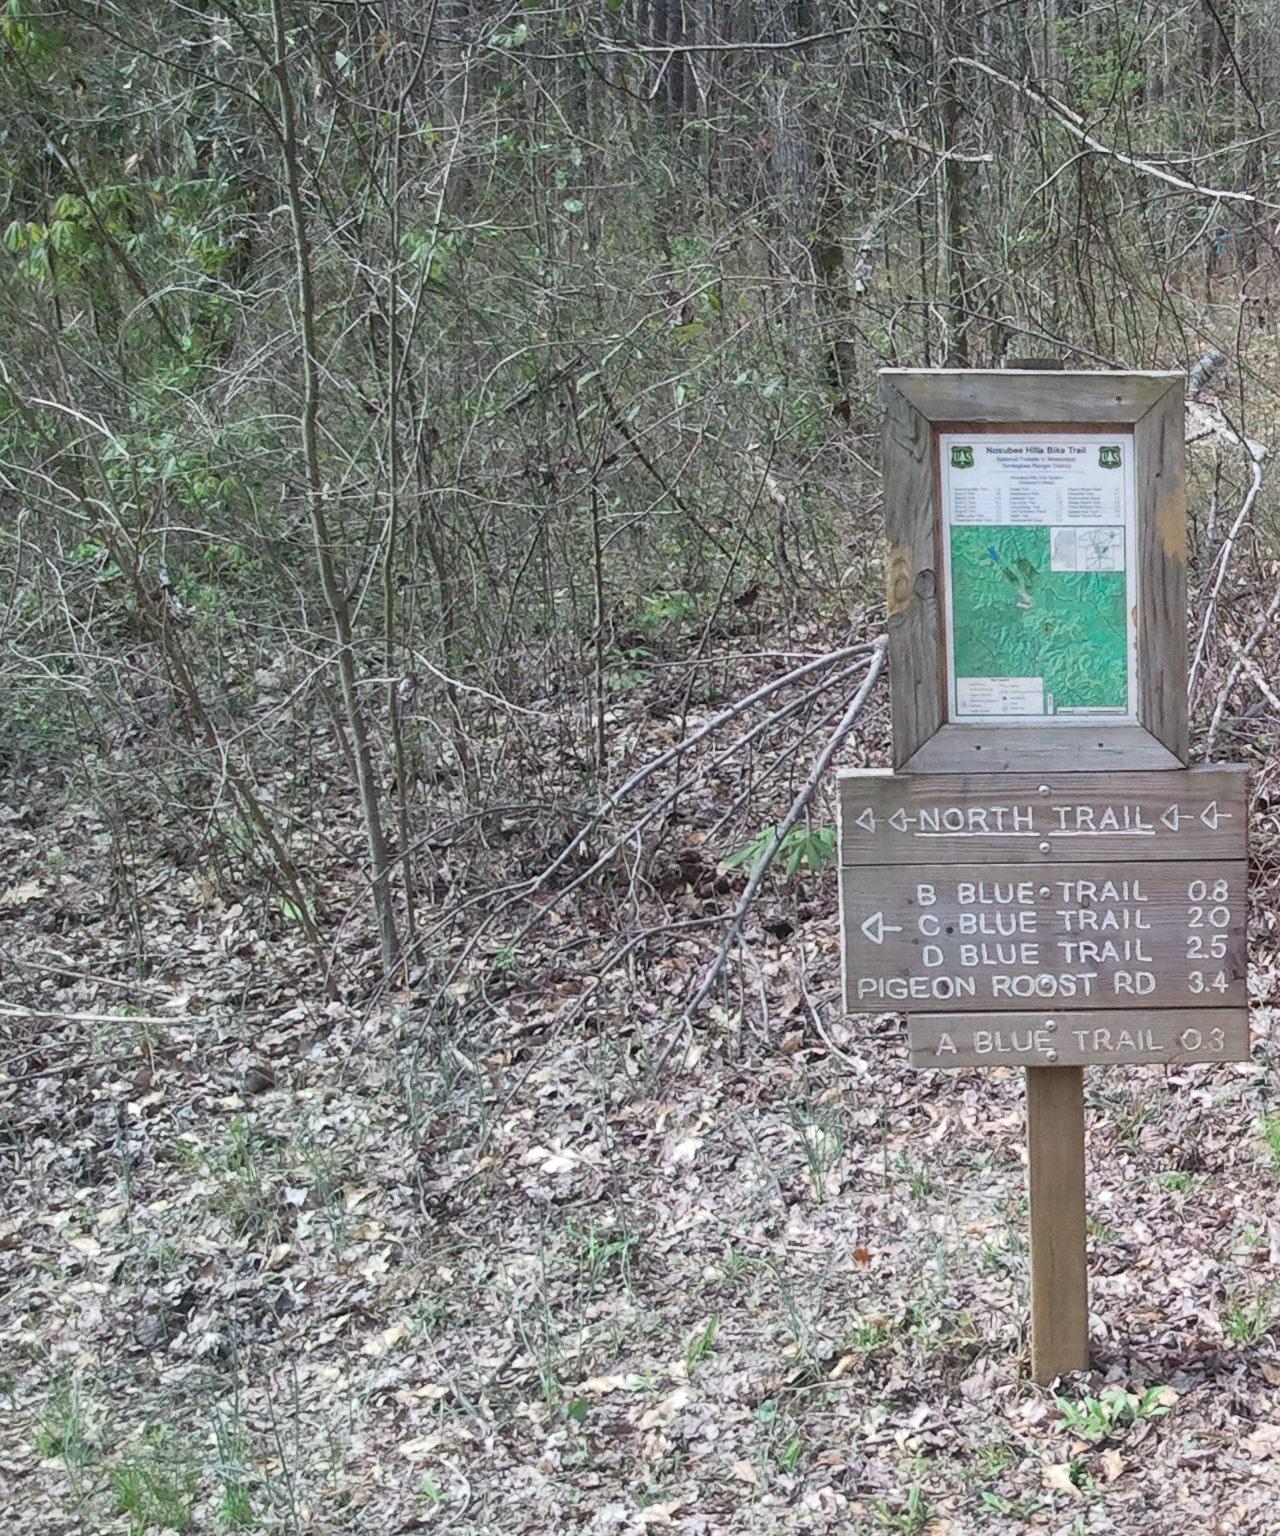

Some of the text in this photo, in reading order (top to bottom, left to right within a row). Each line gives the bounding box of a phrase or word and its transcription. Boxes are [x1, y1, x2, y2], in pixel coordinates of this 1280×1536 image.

[918, 805, 1154, 833] NORTH TRAIL
[917, 880, 1229, 906] B BLUE TRAIL 0.8
[918, 914, 941, 937] C
[959, 912, 1037, 935] BLUE
[1057, 909, 1152, 932] TRAIL
[923, 935, 1228, 967] D BLUE TRAIL 2.5
[857, 971, 1230, 1000] PIGEON ROOST RD 3.4
[935, 1027, 1225, 1057] A BLUE TRAIL 0.3
